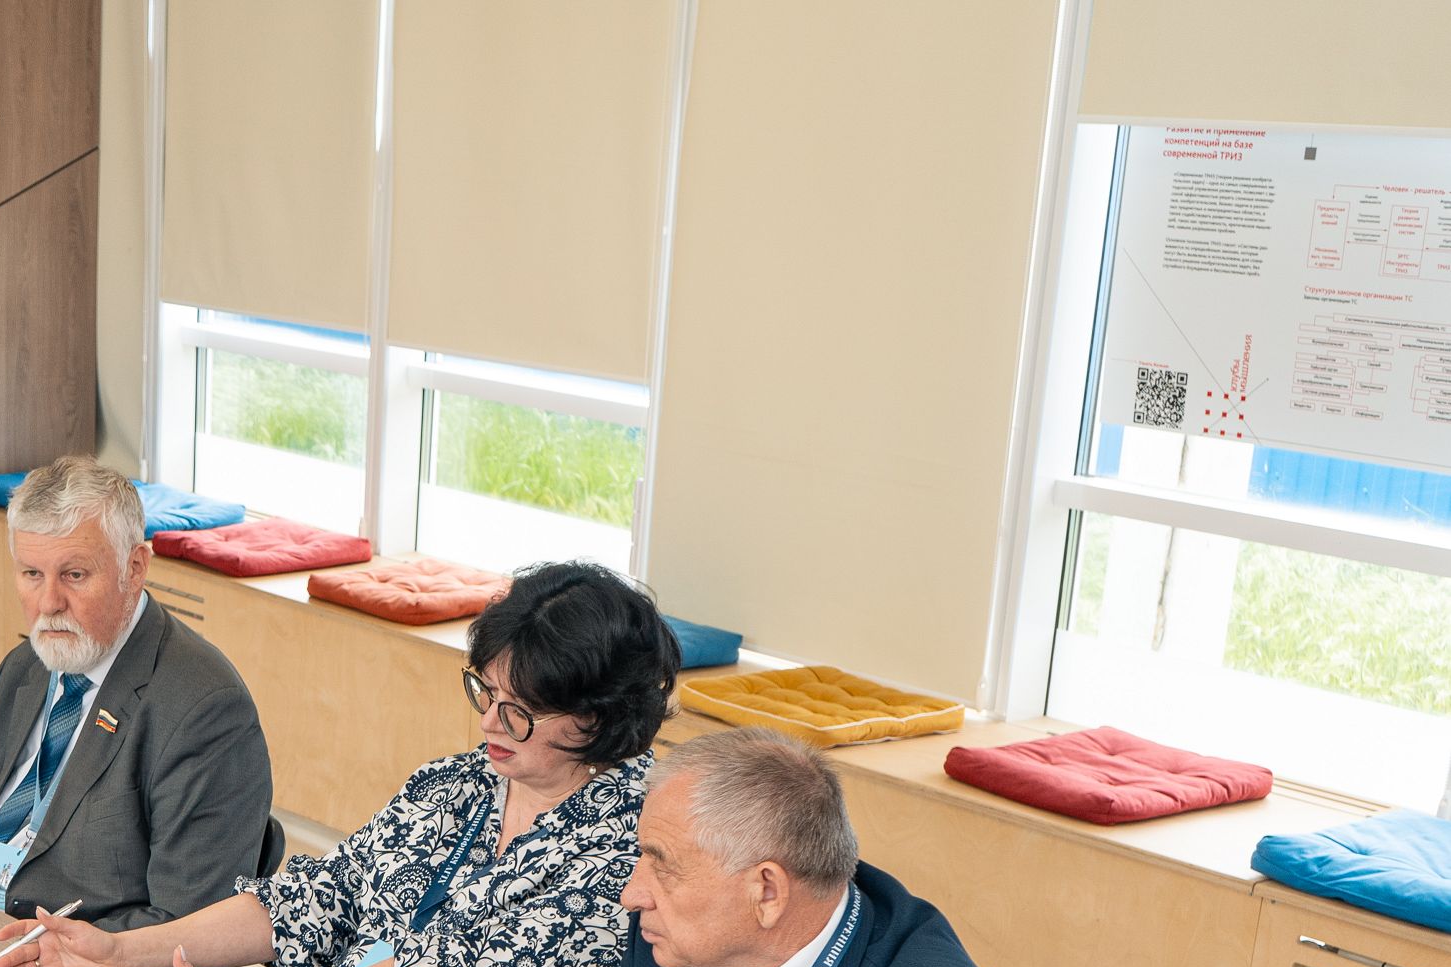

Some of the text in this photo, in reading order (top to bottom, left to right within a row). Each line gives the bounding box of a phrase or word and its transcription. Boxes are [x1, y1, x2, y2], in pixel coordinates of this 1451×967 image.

[1164, 138, 1220, 149] компетенций
[1234, 139, 1254, 150] базе
[1162, 150, 1243, 161] современной ТРИЗ
[438, 865, 453, 886] XLIV
